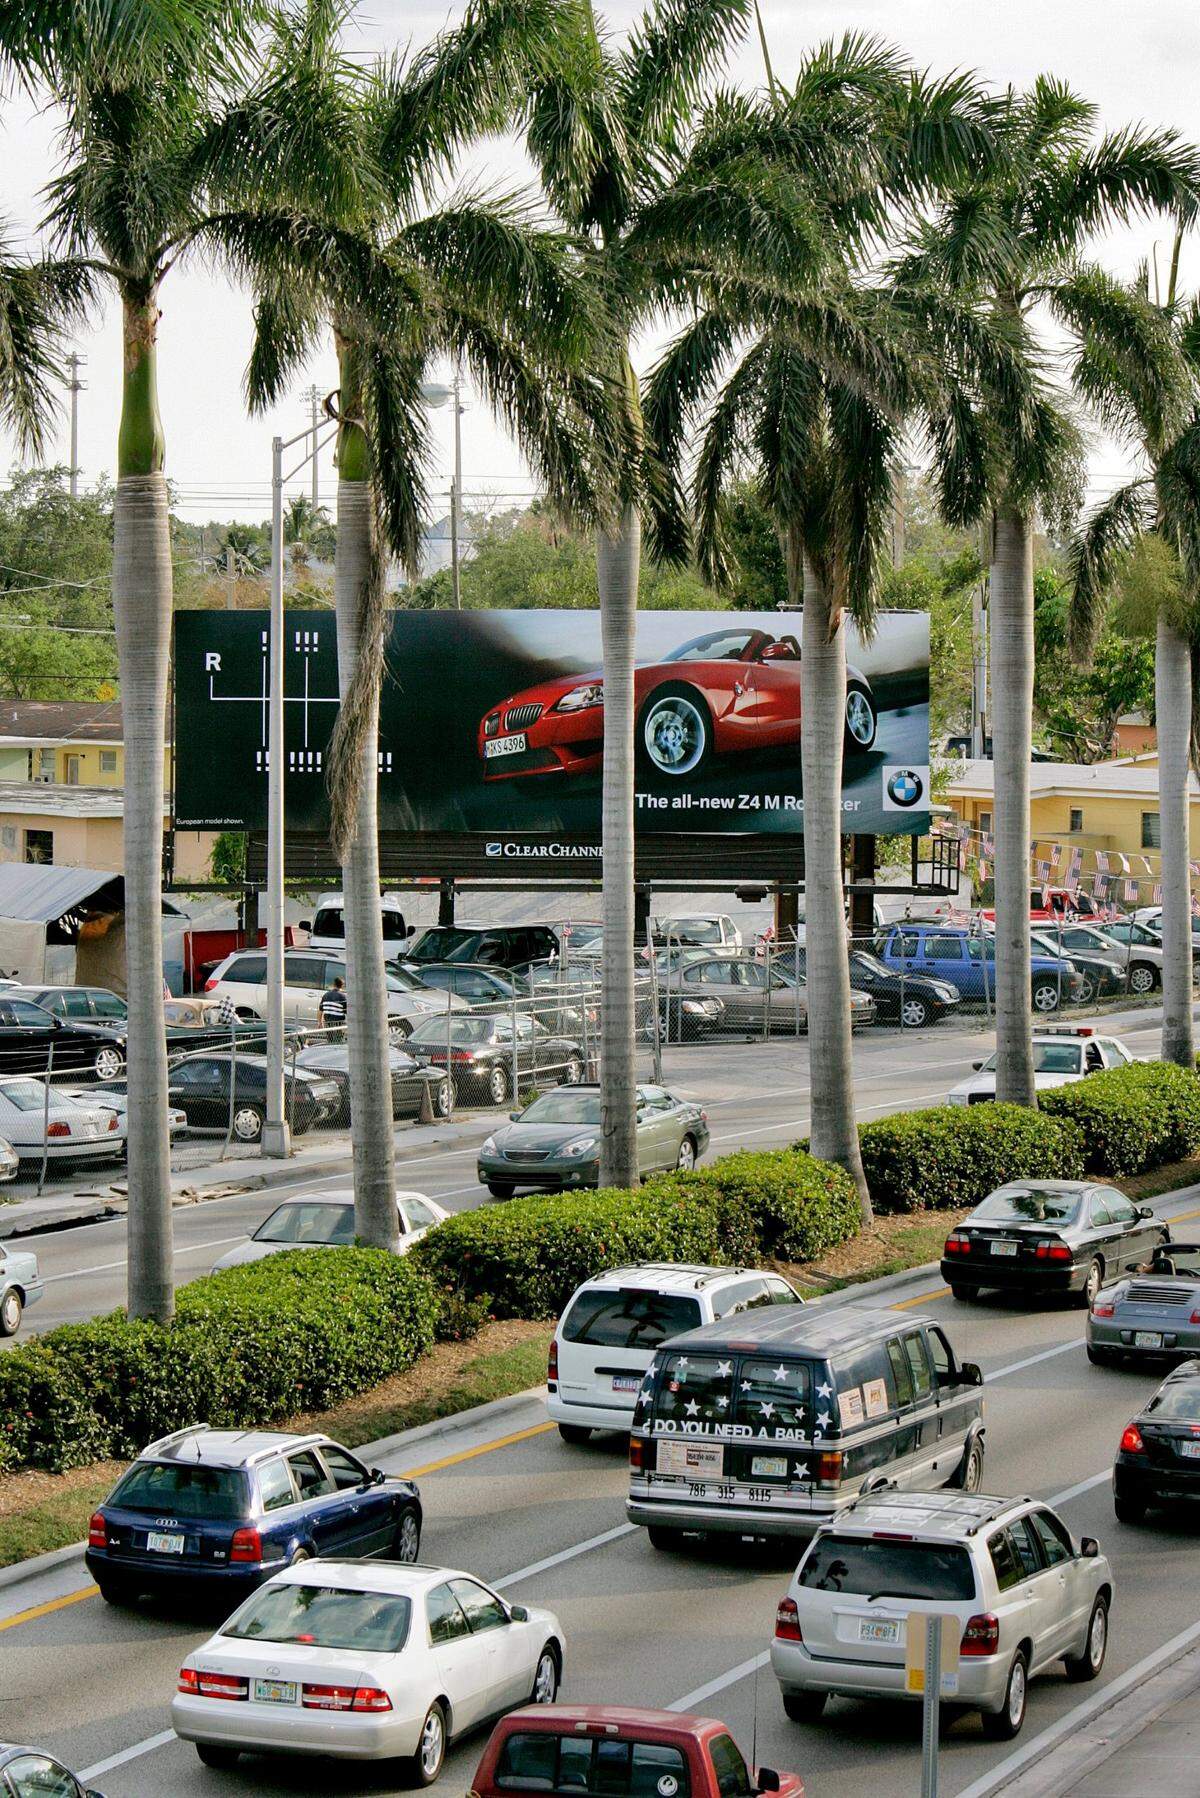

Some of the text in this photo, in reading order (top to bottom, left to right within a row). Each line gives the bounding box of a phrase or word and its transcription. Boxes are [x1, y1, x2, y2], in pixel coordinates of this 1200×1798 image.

[205, 652, 221, 671] R
[503, 735, 525, 751] 4396
[635, 793, 668, 809] The
[671, 793, 735, 810] all-new
[738, 795, 760, 810] Z4
[764, 795, 780, 811] M
[655, 1418, 677, 1433] DO
[681, 1420, 709, 1435] YOU
[714, 1423, 753, 1438] NEED
[758, 1426, 769, 1440] A
[775, 1427, 806, 1441] BAR
[688, 1483, 771, 1502] 786 315 8115
